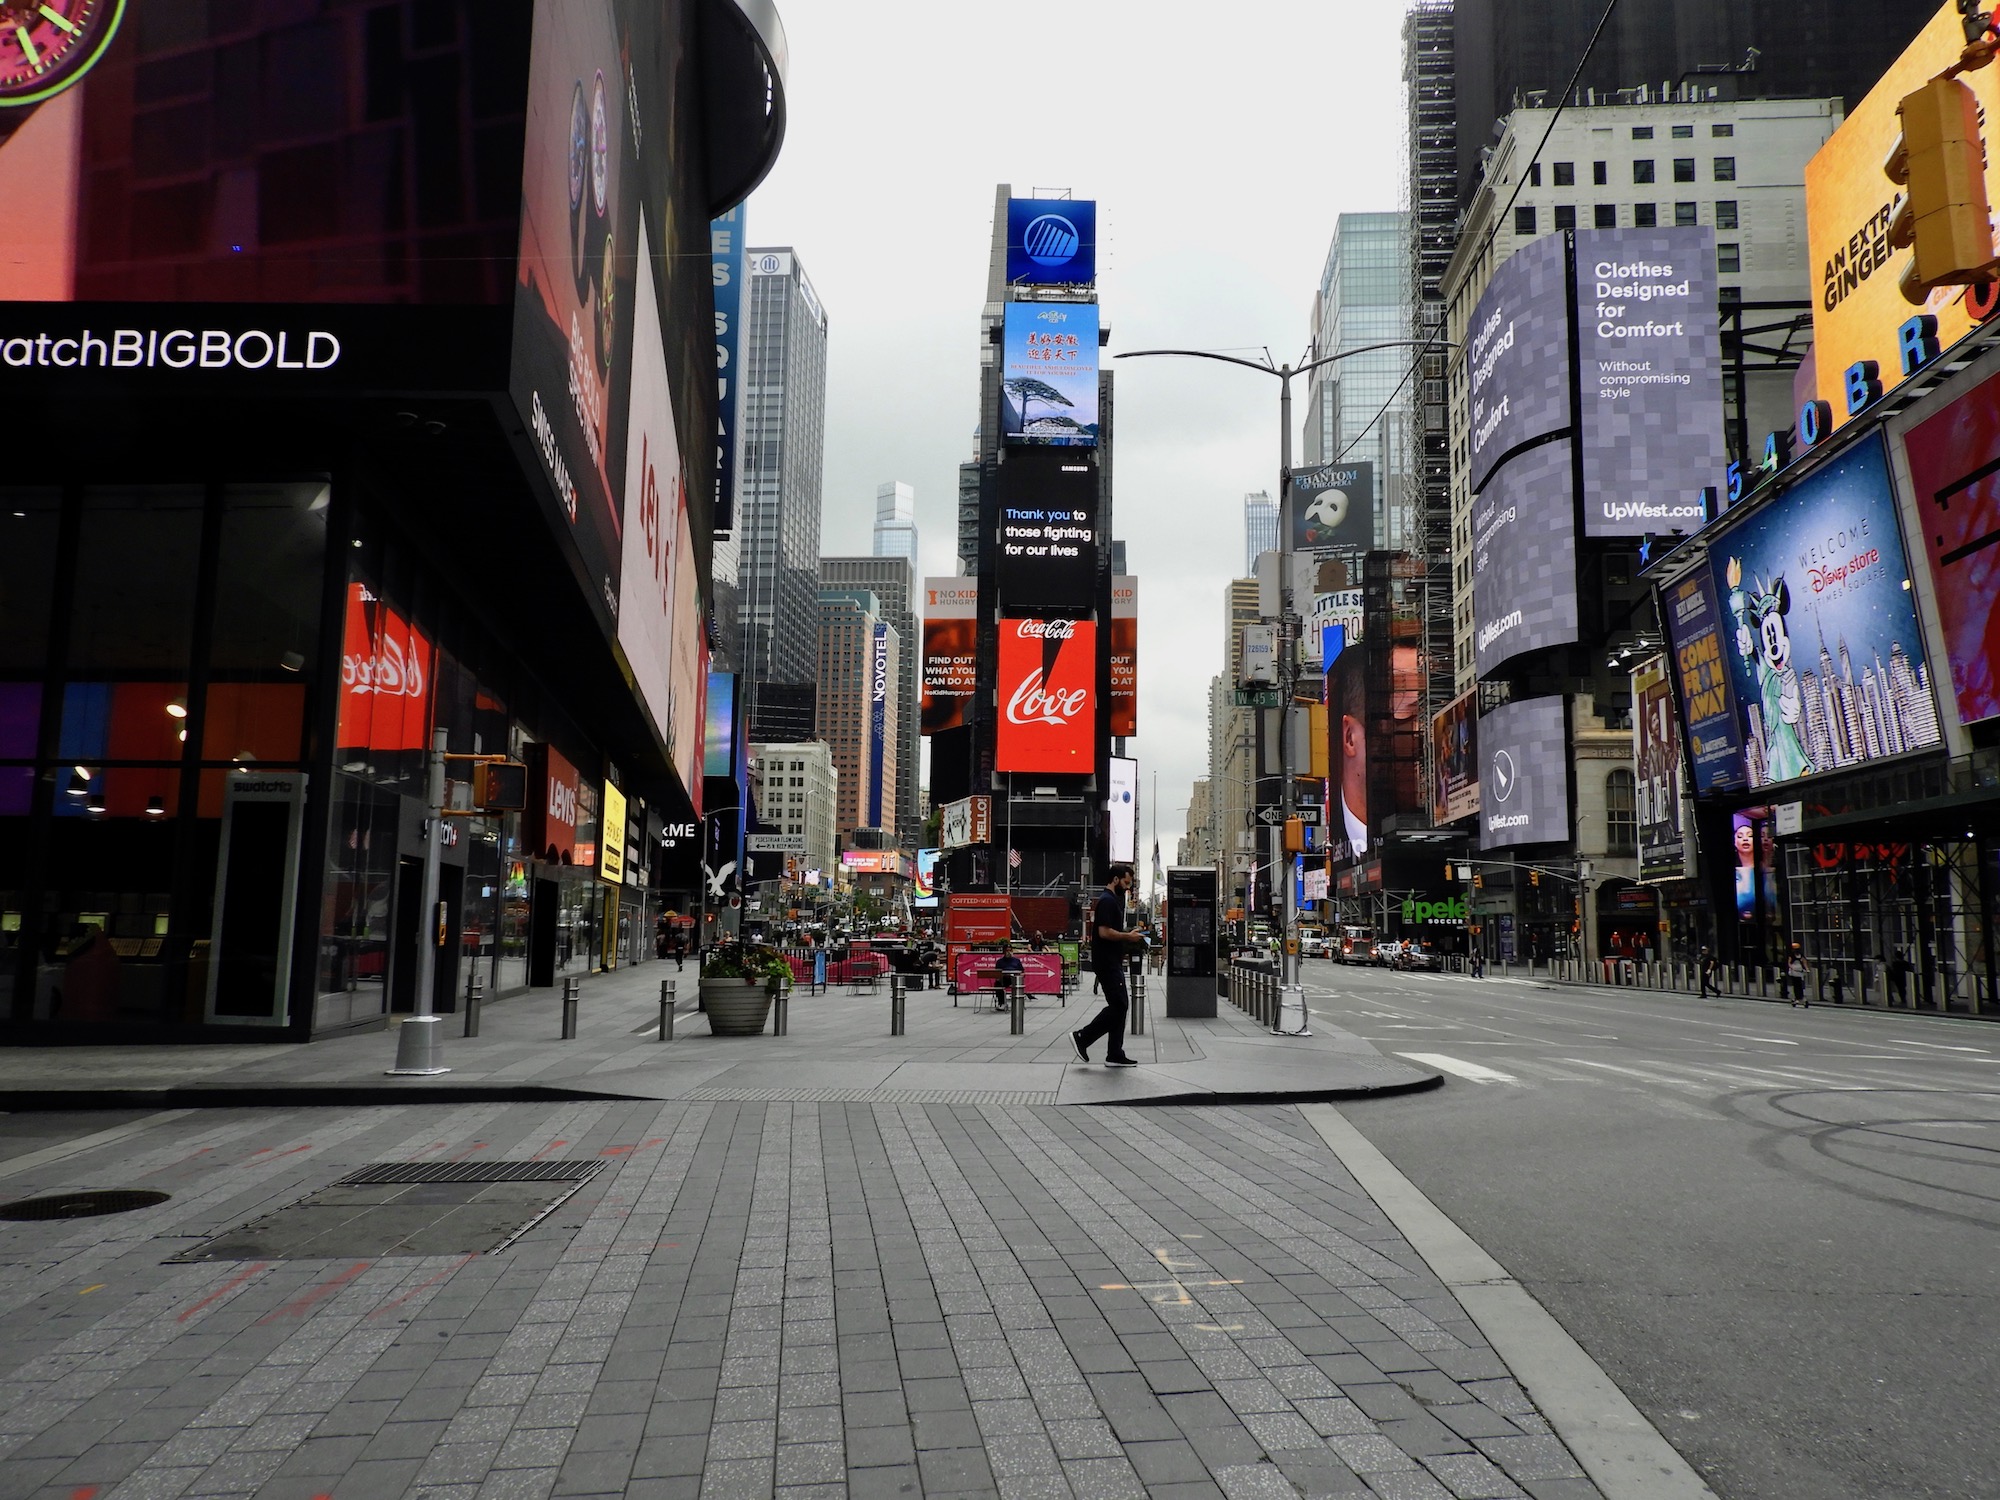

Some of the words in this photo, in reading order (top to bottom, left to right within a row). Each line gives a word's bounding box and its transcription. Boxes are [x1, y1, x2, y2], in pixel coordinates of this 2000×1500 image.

[1595, 261, 1673, 278] Clothes
[1824, 246, 1845, 285] AN
[1596, 280, 1689, 301] Designed
[1596, 302, 1625, 318] for
[1472, 307, 1501, 364] Clothes
[1597, 321, 1683, 338] Comfort
[0, 330, 340, 368] atchBIGBOLD
[1027, 348, 1078, 361] 迎客天下
[1473, 320, 1514, 395] Designed
[1599, 361, 1651, 372] Without
[1600, 373, 1690, 386] compromising
[1600, 387, 1630, 399] style
[1474, 397, 1485, 425] for
[1474, 395, 1509, 454] Comfort
[1295, 470, 1357, 486] PHANTOM
[1006, 509, 1044, 520] Thank
[1047, 510, 1070, 523] you
[1073, 510, 1086, 521] to
[1005, 526, 1041, 537] those
[1043, 526, 1092, 542] fighting
[1005, 543, 1024, 555] for
[1026, 546, 1048, 556] our
[1051, 544, 1079, 556] lives
[1798, 518, 1870, 569] WELCOME
[1849, 548, 1879, 574] store
[940, 590, 956, 599] NO
[957, 590, 977, 599] KID
[1113, 589, 1133, 598] KID
[929, 656, 951, 664] FIND
[953, 656, 973, 665] OUT
[1680, 632, 1720, 673] COME
[873, 631, 887, 702] NOVOTEL
[925, 667, 953, 675] WHAT
[956, 667, 976, 675] YOU
[925, 677, 945, 685] CAN
[947, 677, 962, 685] DO
[1120, 677, 1133, 685] AT
[1238, 692, 1248, 704] W
[1253, 692, 1266, 704] 45
[1689, 684, 1726, 724] AWAY
[976, 798, 987, 841] HELLO!
[1264, 811, 1282, 820] ONE
[1488, 814, 1529, 833] UpWest.com
